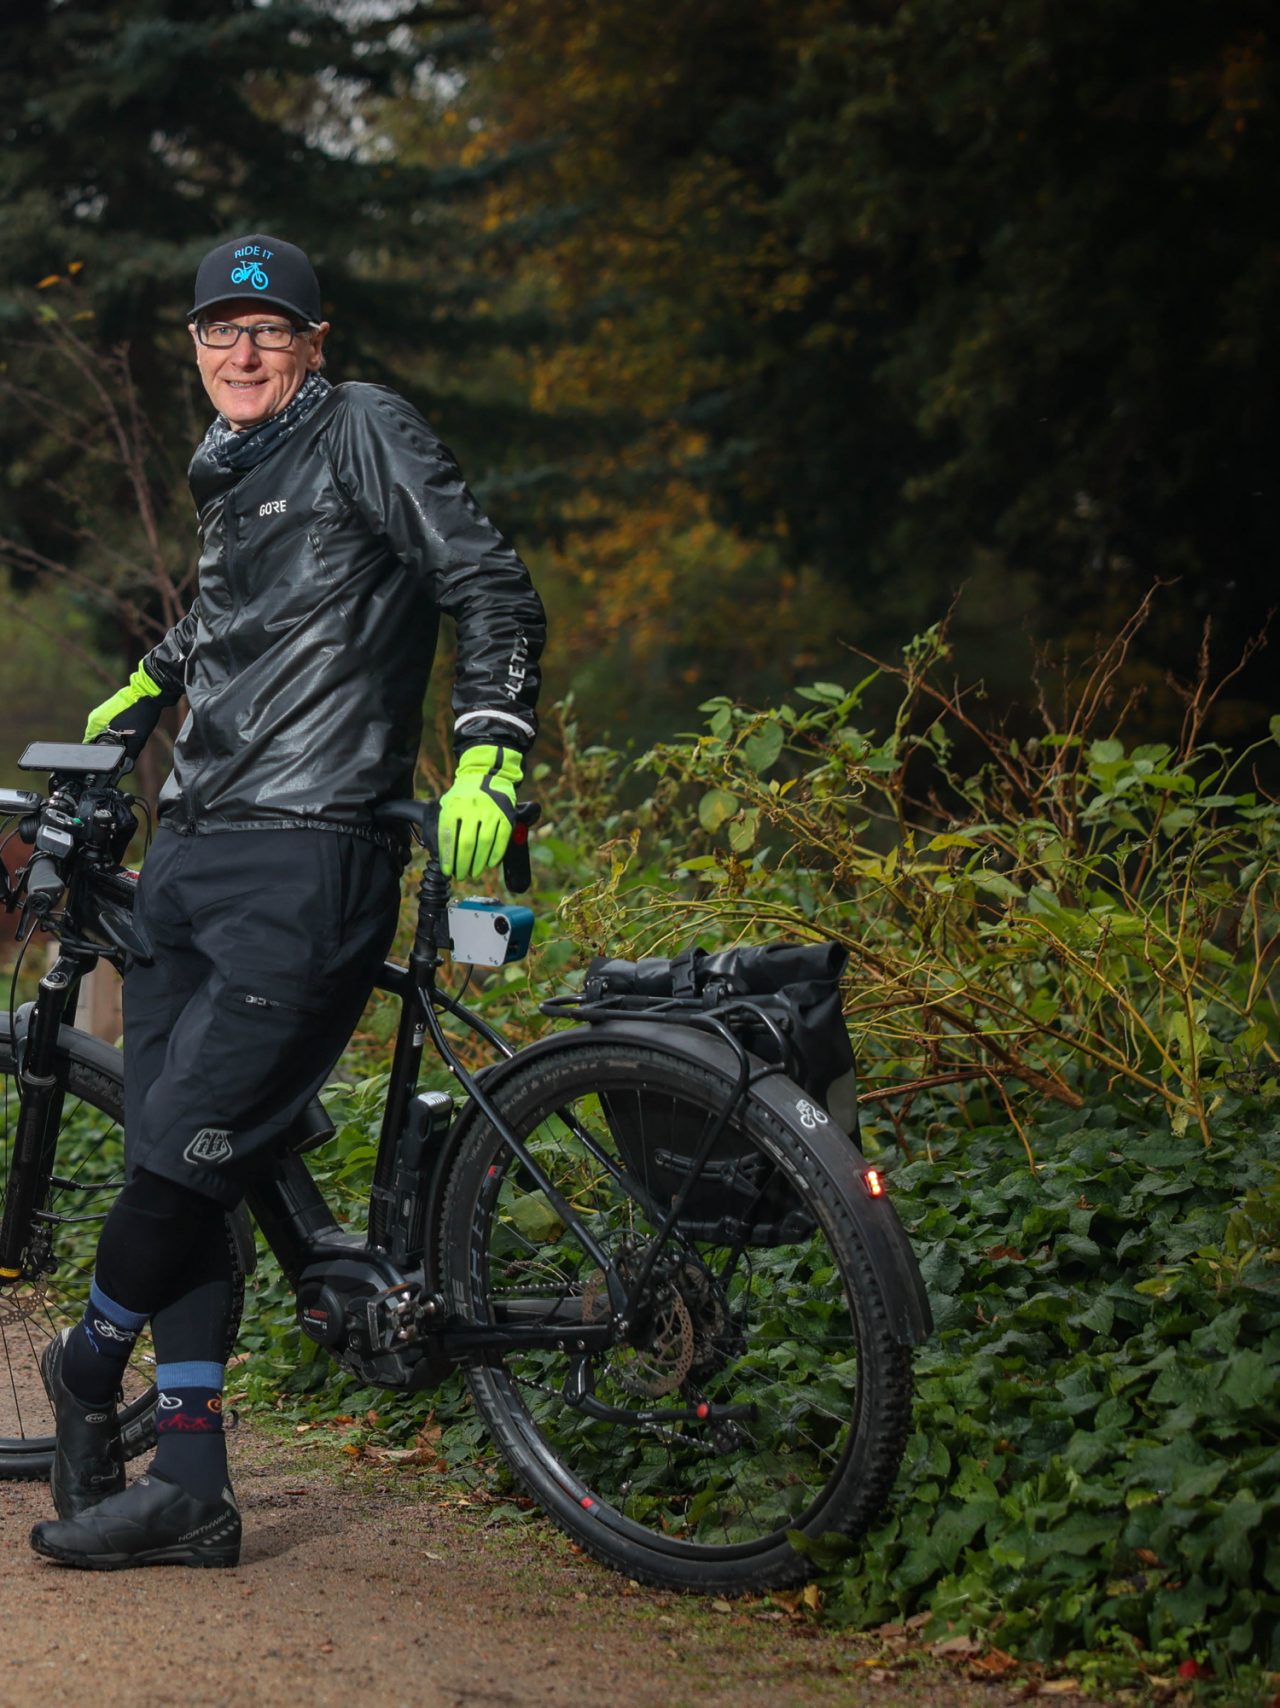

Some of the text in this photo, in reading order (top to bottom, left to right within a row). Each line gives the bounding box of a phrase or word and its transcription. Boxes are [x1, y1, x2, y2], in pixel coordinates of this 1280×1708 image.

[234, 245, 274, 260] RIDE IT
[259, 499, 287, 517] GORE
